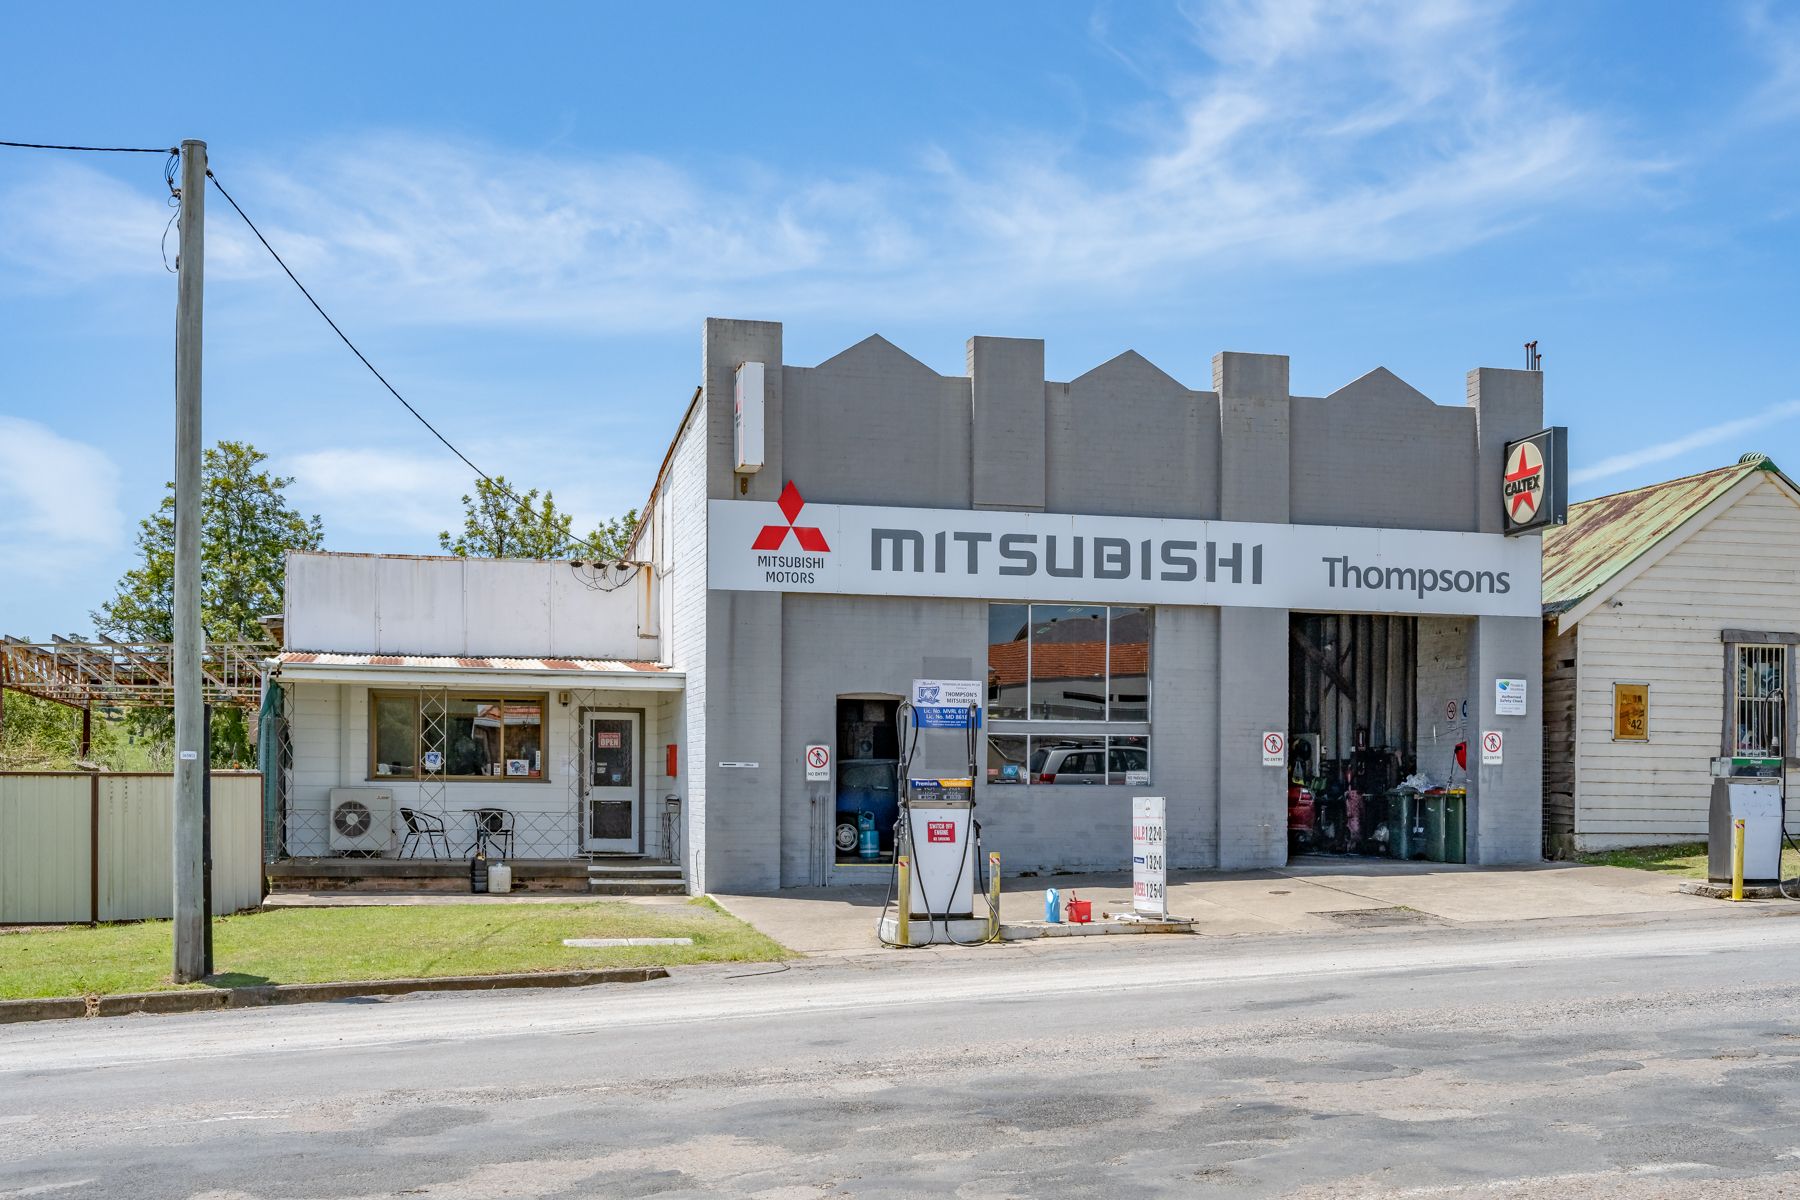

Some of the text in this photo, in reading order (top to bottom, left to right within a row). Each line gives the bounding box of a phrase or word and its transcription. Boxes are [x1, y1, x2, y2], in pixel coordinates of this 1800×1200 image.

[1504, 475, 1540, 496] CALTEX
[758, 556, 824, 568] MITSUBISHI
[870, 528, 1262, 585] MITSUBISHI
[766, 572, 814, 584] MOTORS
[1322, 556, 1510, 599] Thompsons
